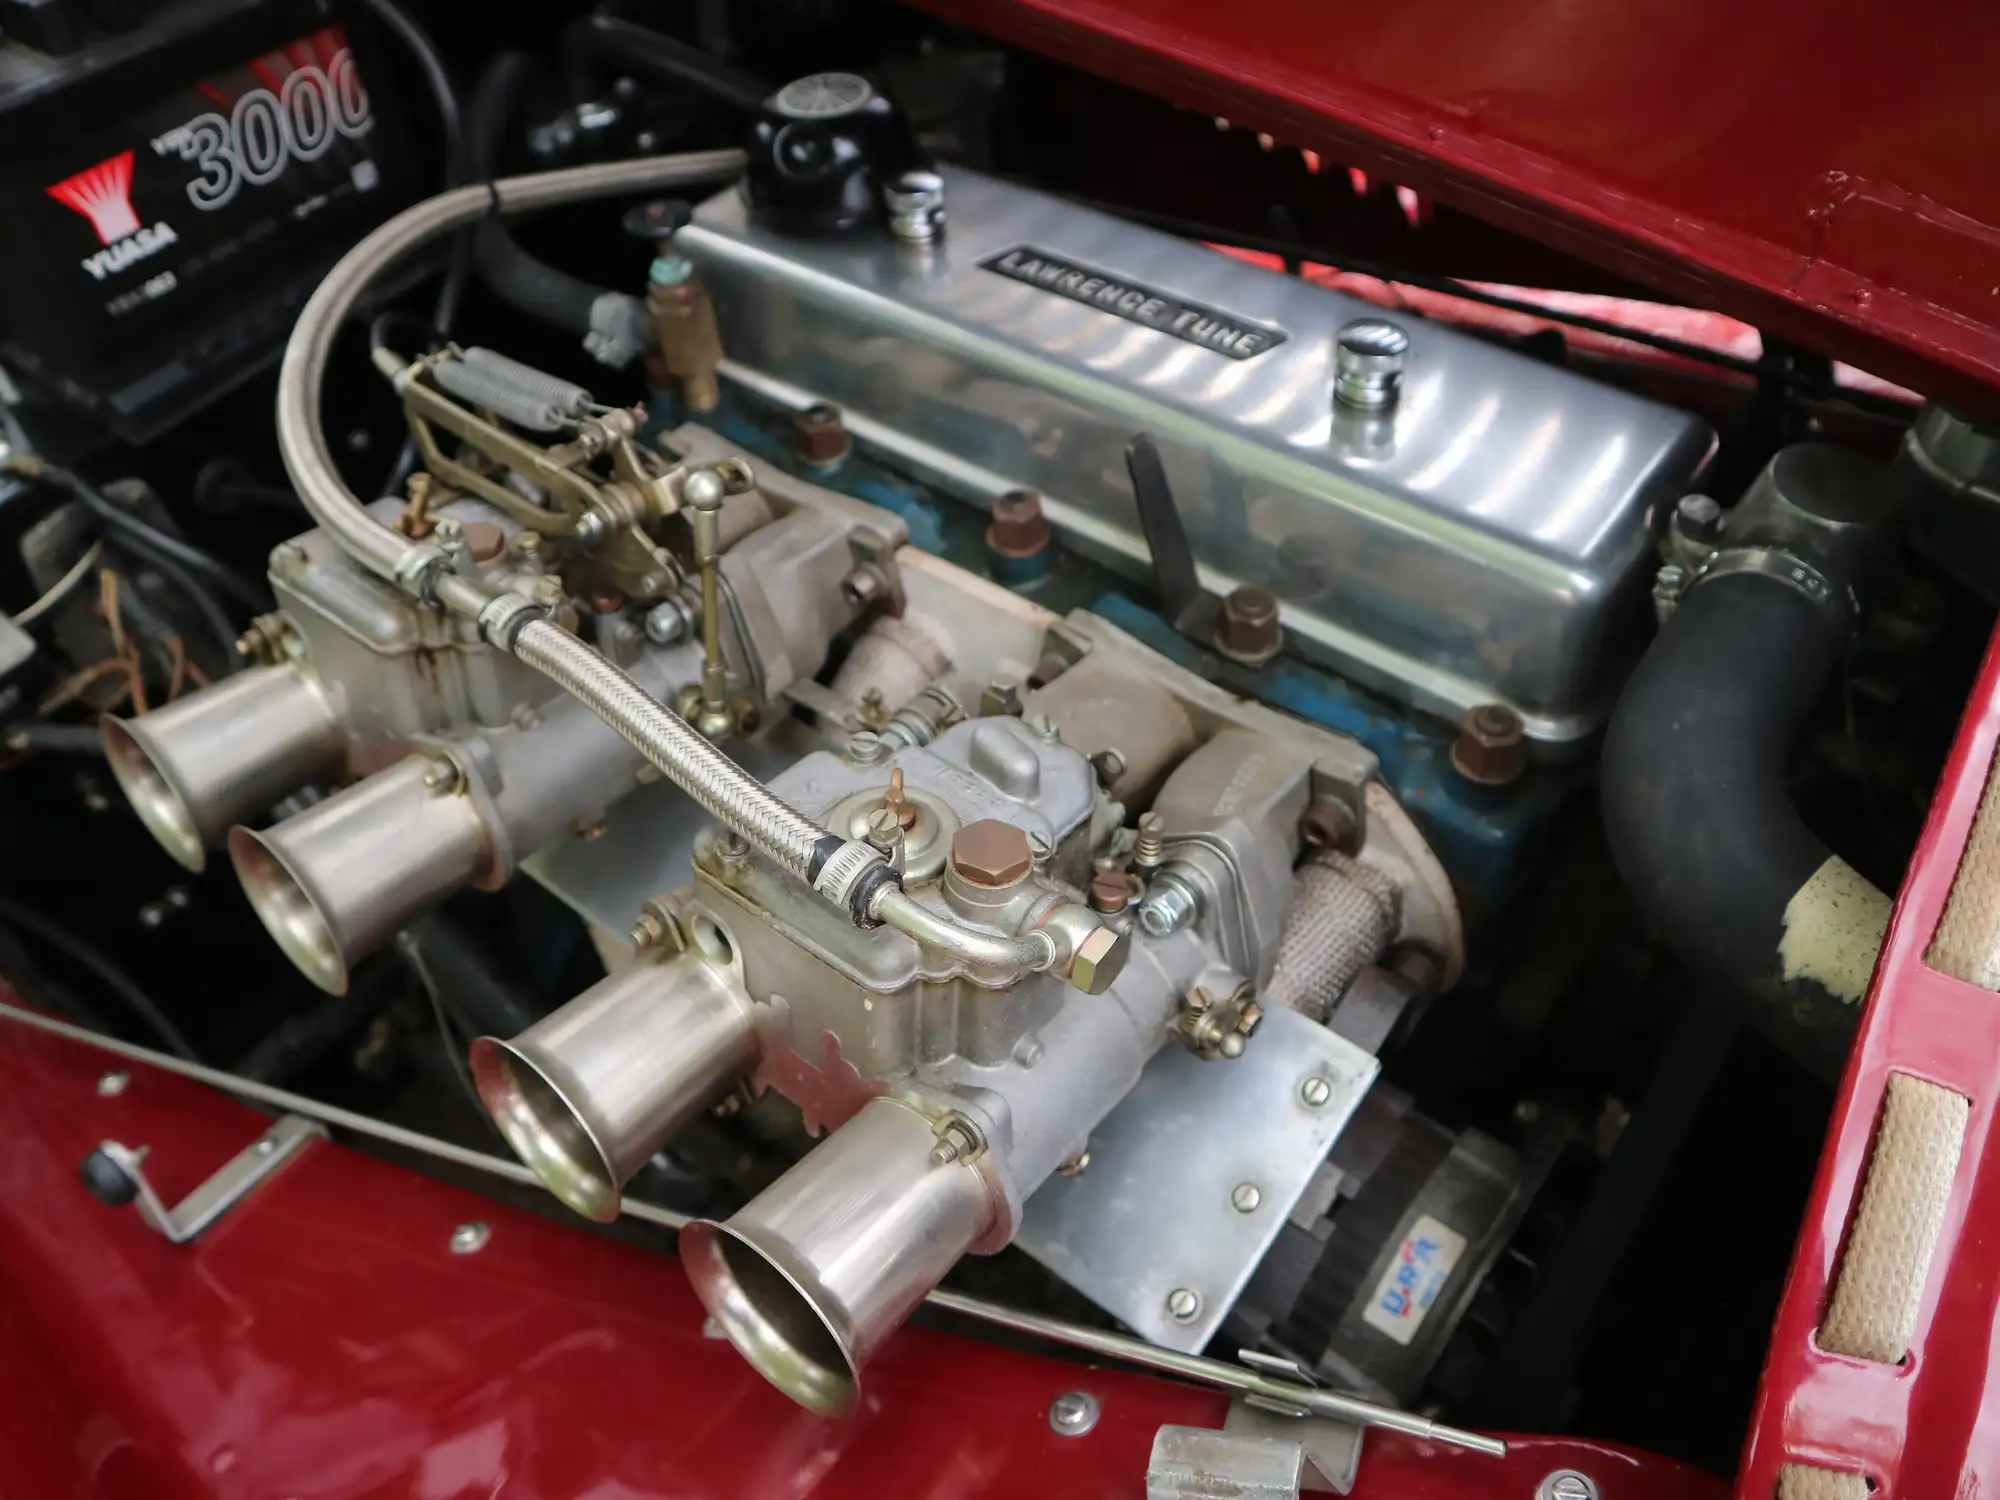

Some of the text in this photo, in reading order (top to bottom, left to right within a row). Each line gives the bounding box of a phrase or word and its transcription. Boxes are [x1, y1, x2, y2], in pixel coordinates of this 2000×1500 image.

[82, 222, 178, 280] YUASA
[999, 251, 1264, 353] LAWRENCE TUNE
